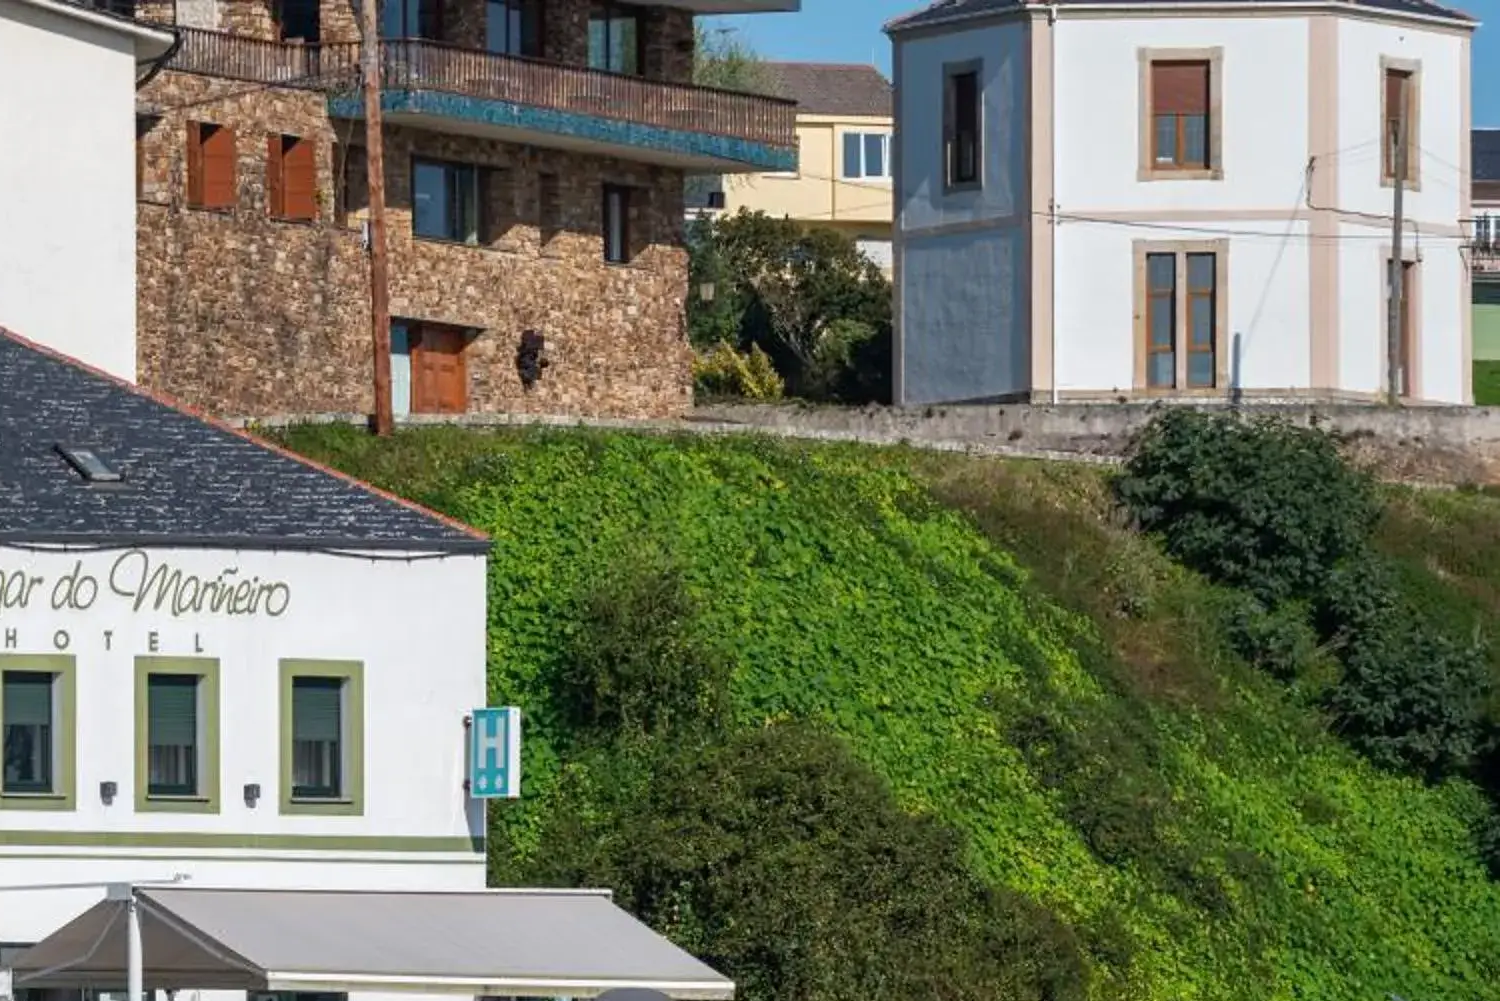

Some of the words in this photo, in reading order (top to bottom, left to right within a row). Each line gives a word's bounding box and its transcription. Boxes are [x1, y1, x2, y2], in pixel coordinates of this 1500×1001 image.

[50, 559, 100, 611] do
[108, 548, 291, 618] Mariñeiro
[4, 627, 205, 654] HOTEL
[477, 717, 505, 769] H
